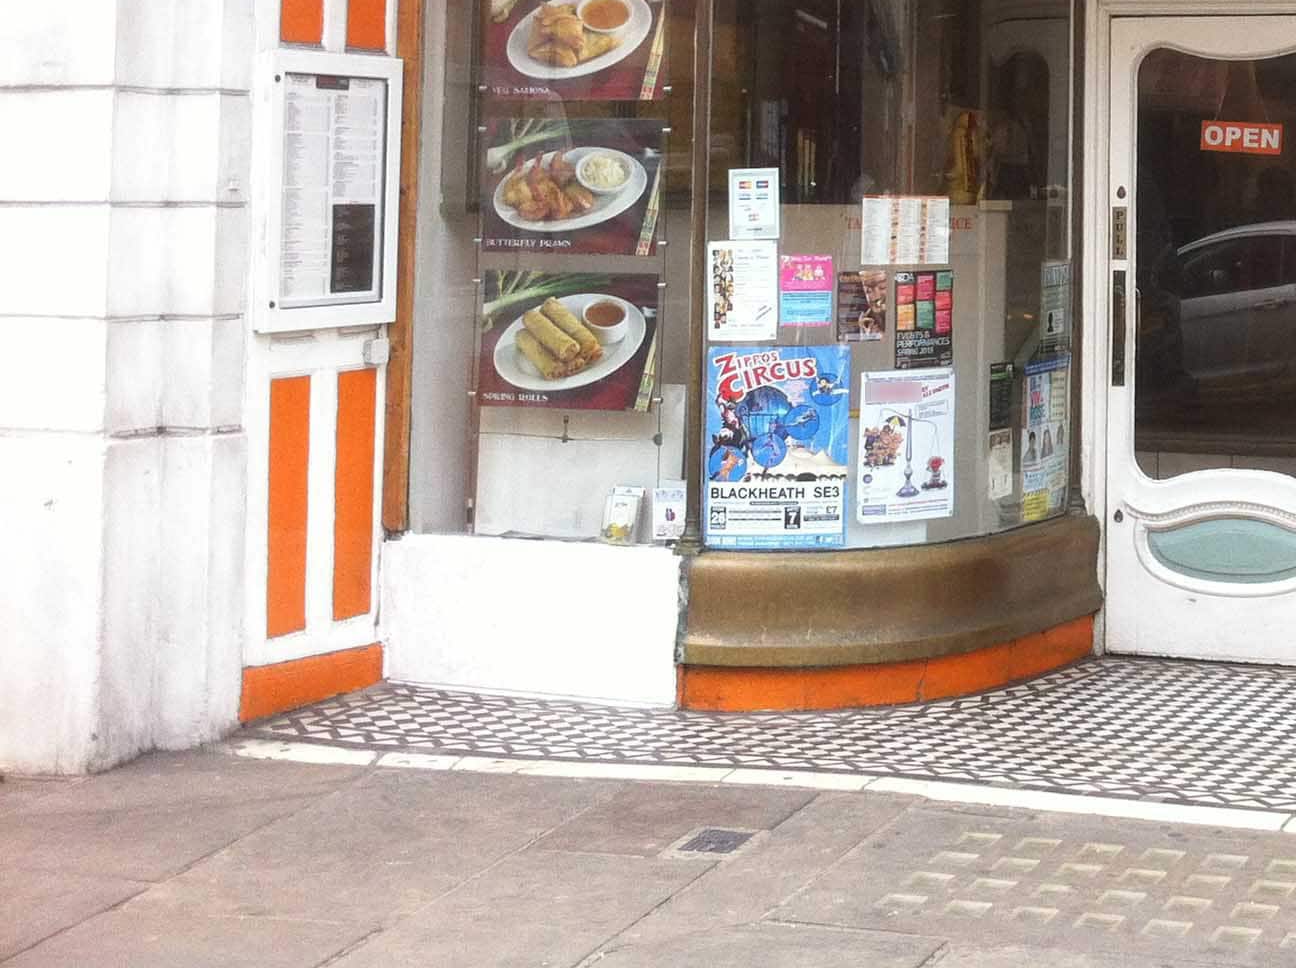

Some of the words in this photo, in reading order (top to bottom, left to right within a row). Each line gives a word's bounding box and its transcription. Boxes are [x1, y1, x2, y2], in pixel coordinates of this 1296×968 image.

[1204, 125, 1280, 149] OPEN
[485, 237, 536, 247] BUTTERFLY
[713, 352, 779, 377] ZIPPOS
[718, 359, 817, 402] CIRCUS
[710, 487, 805, 500] BLACKHEATH
[813, 486, 840, 498] SE3
[788, 512, 798, 525] 7
